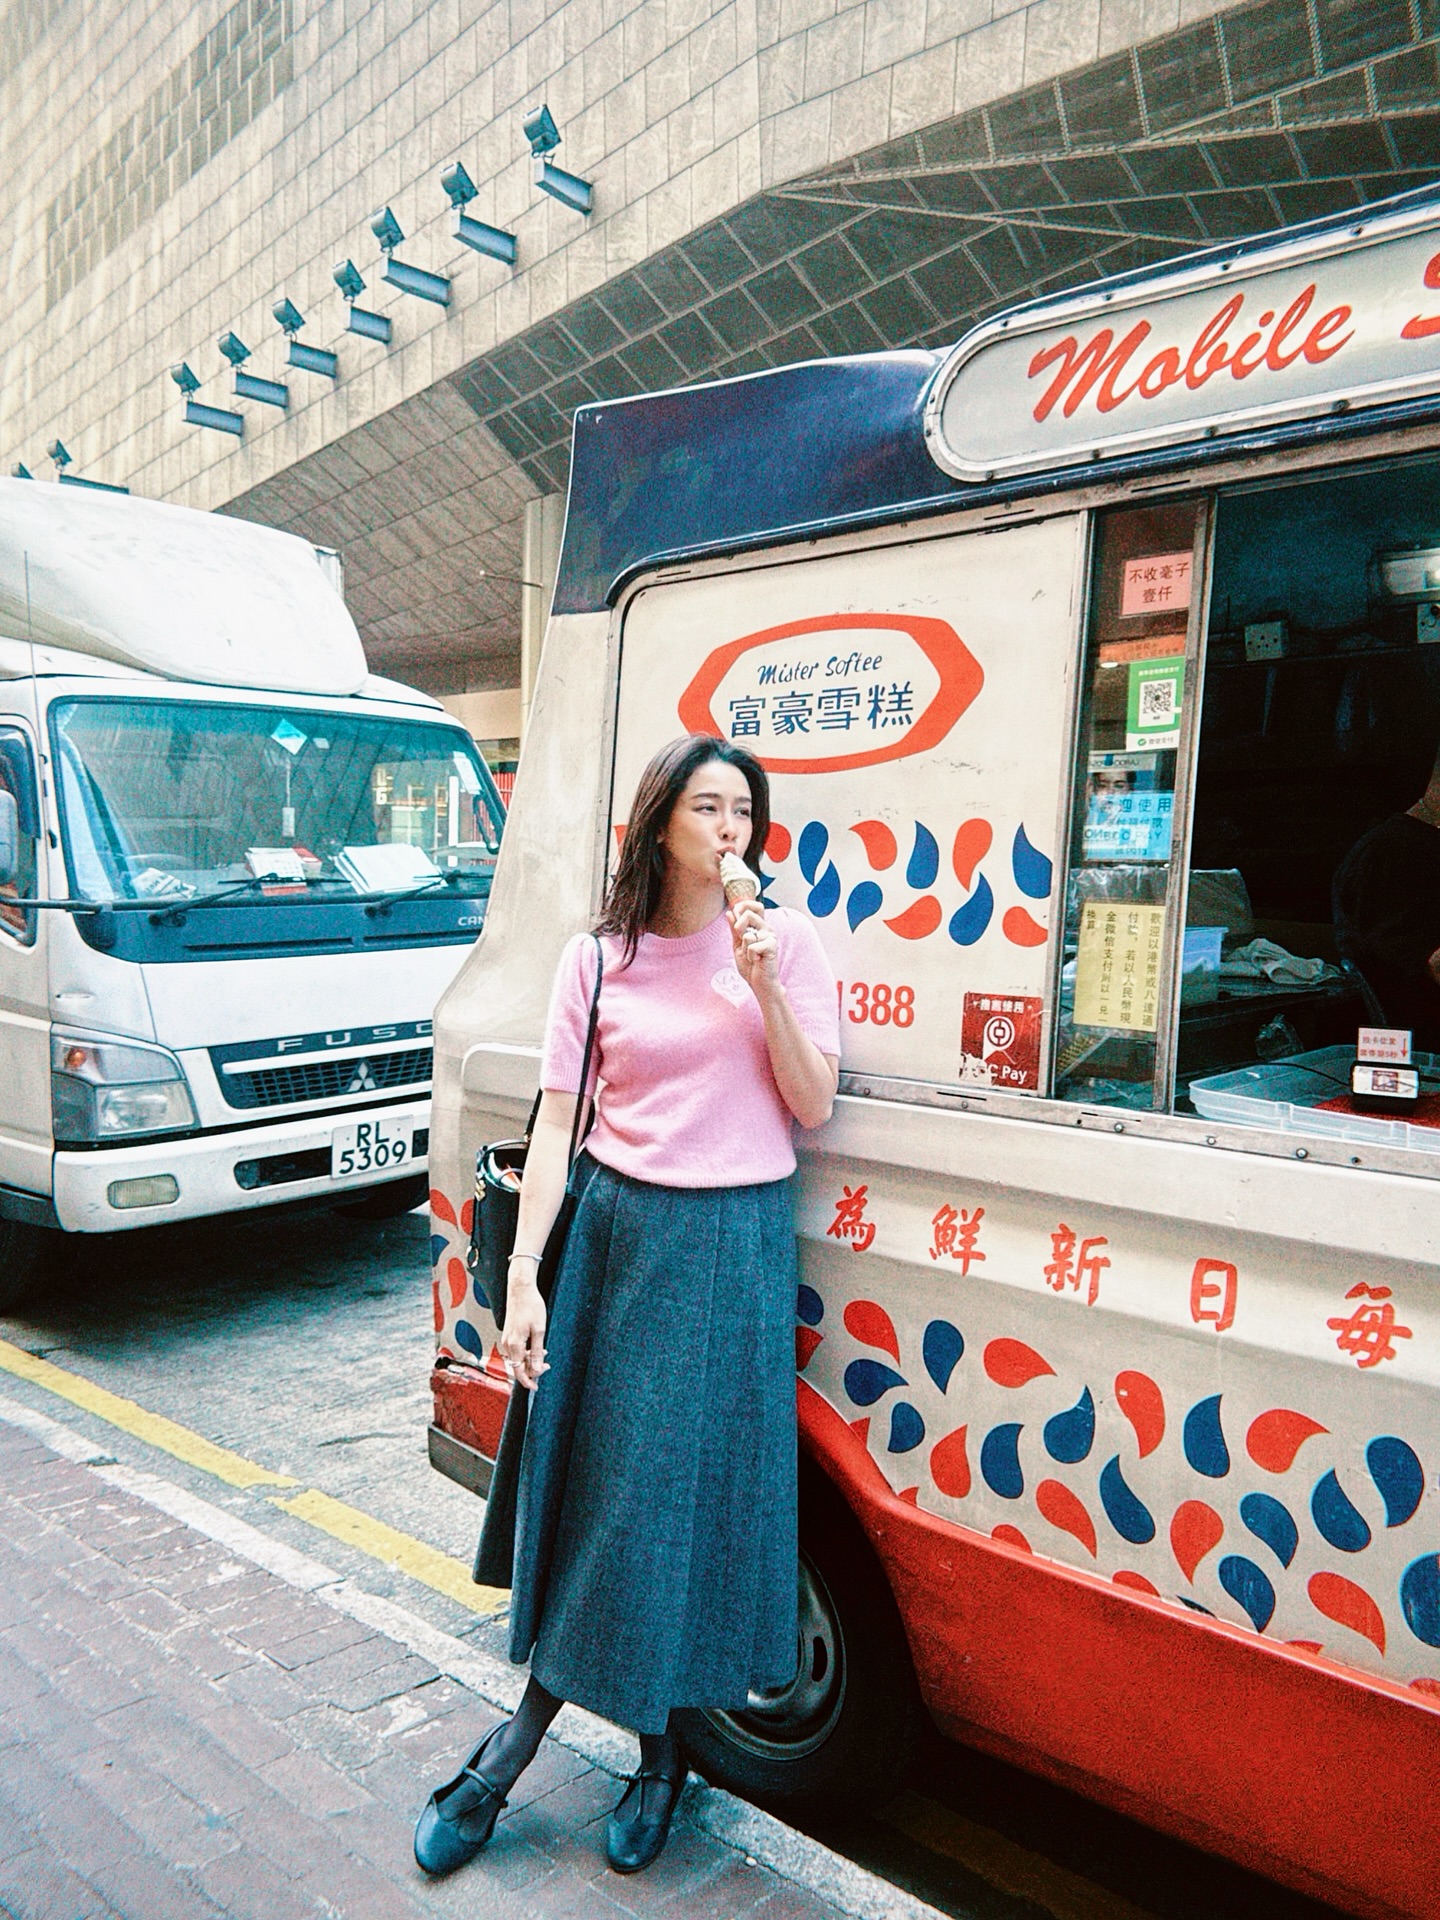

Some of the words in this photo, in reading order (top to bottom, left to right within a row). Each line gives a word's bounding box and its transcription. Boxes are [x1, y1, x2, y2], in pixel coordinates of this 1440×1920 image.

[1027, 283, 1355, 424] Mobile
[1129, 562, 1189, 583] 不收毫子
[1142, 586, 1172, 603] 壹仟
[757, 662, 819, 686] Mister
[825, 652, 883, 677] Softee
[728, 681, 914, 739] 富豪雪糕
[1002, 1063, 1027, 1084] Pay
[356, 1121, 389, 1148] RL
[339, 1140, 407, 1175] 5309
